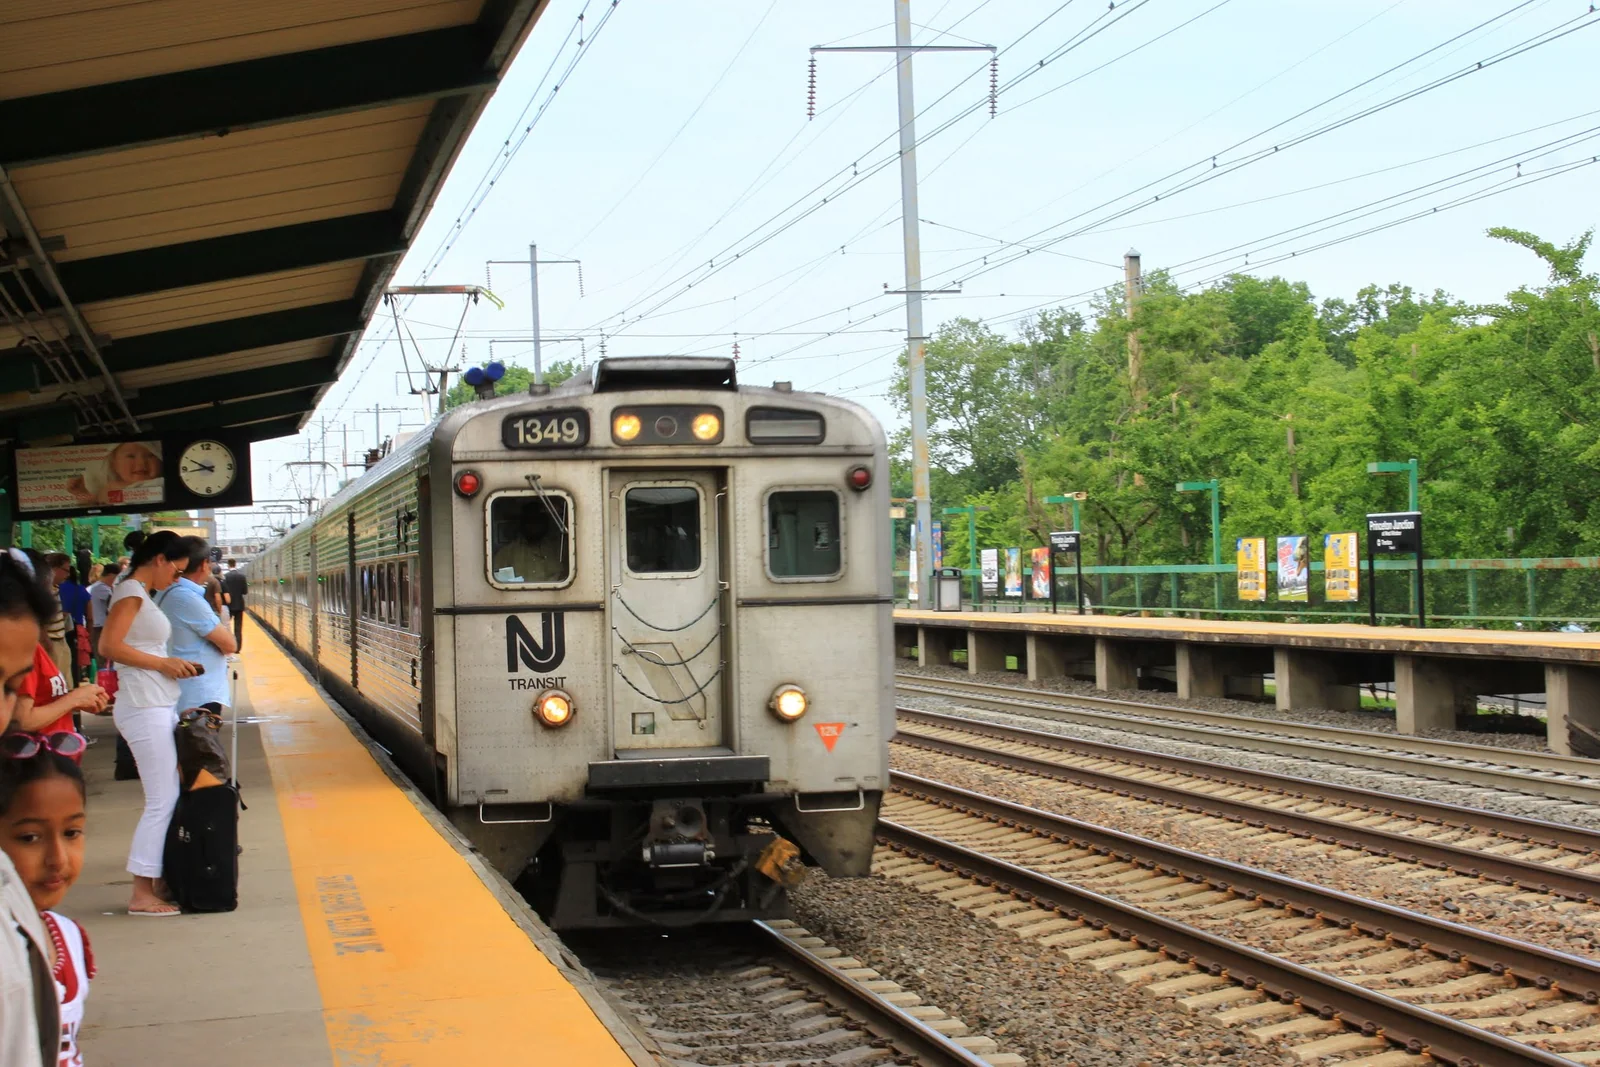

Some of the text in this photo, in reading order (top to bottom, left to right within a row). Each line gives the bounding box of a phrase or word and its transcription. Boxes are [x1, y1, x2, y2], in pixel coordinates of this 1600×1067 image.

[513, 417, 580, 444] 1349
[200, 443, 212, 451] 12
[181, 465, 188, 473] 9
[226, 463, 233, 471] 3
[205, 486, 212, 494] 6
[506, 612, 566, 674] NJ
[508, 676, 567, 691] TRANSIT
